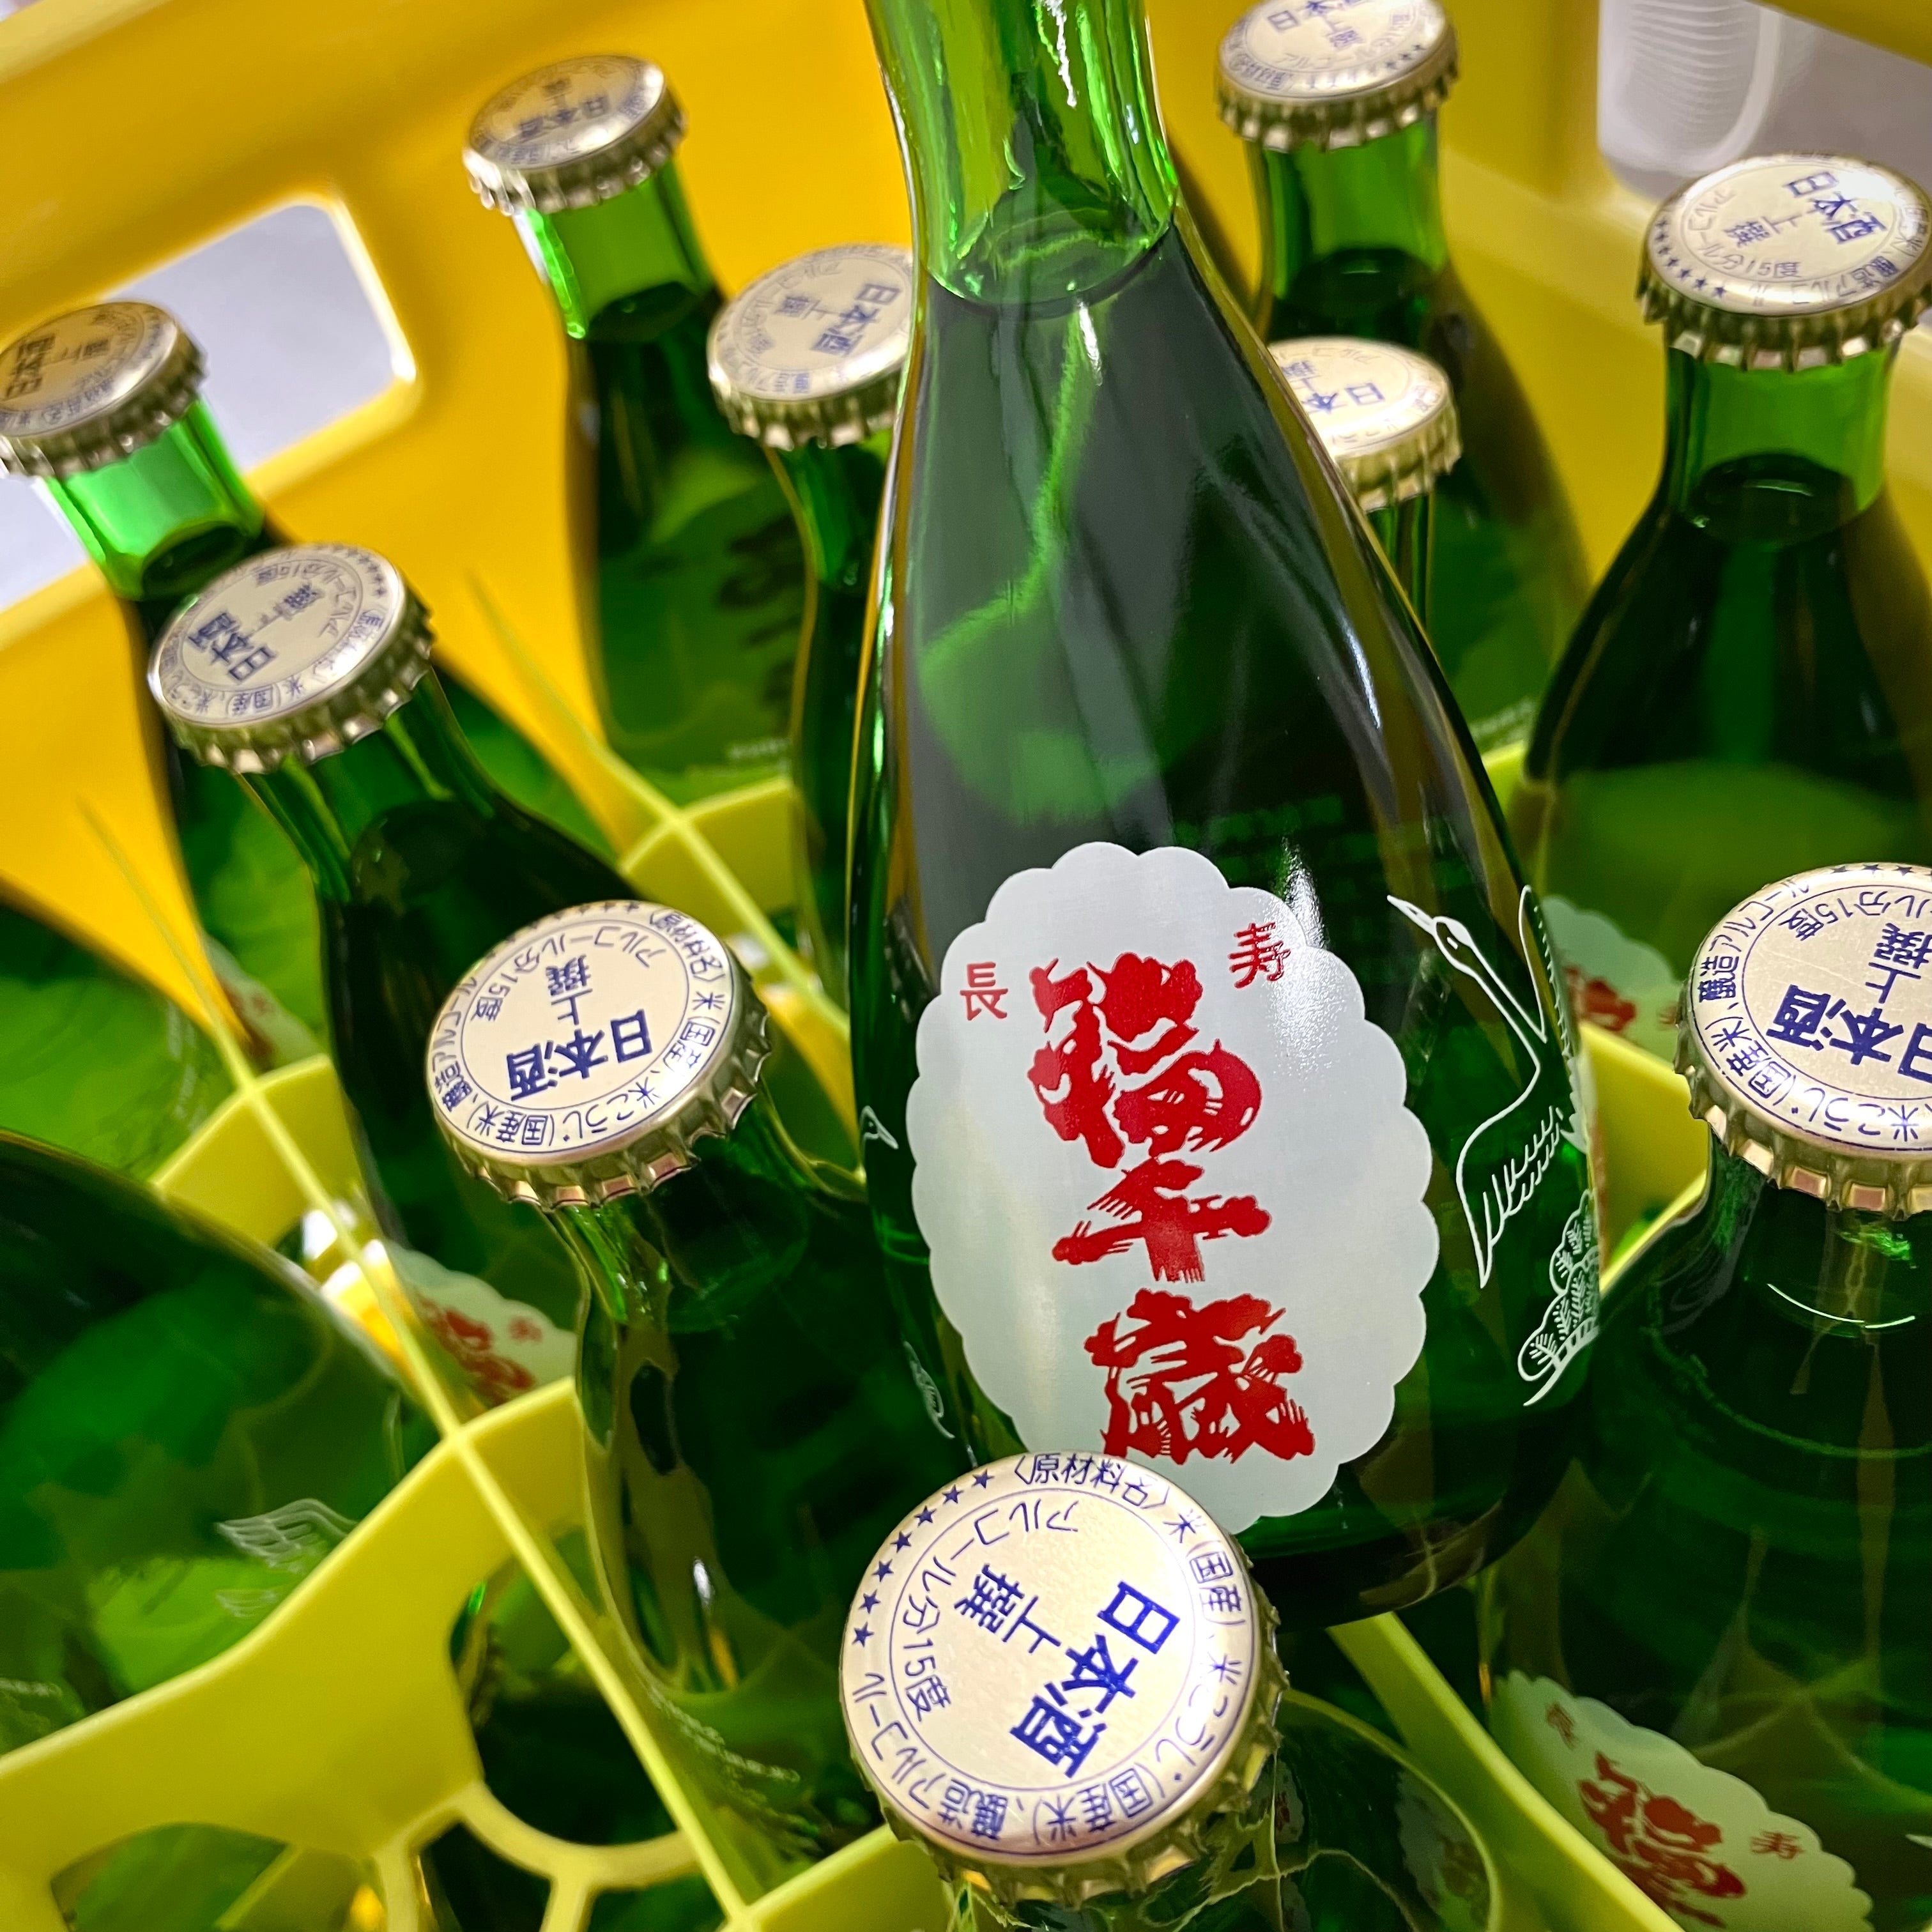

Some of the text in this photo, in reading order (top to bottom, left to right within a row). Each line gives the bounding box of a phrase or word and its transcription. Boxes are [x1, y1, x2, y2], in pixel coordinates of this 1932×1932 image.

[471, 925, 666, 1022] アルコール分15度
[960, 921, 1291, 1021] 長 寿
[507, 1009, 652, 1101] 日本酒
[903, 1499, 1079, 1721] アルコール分15度
[953, 1563, 1062, 1654] 上撰
[1010, 1580, 1181, 1778] 日本酒
